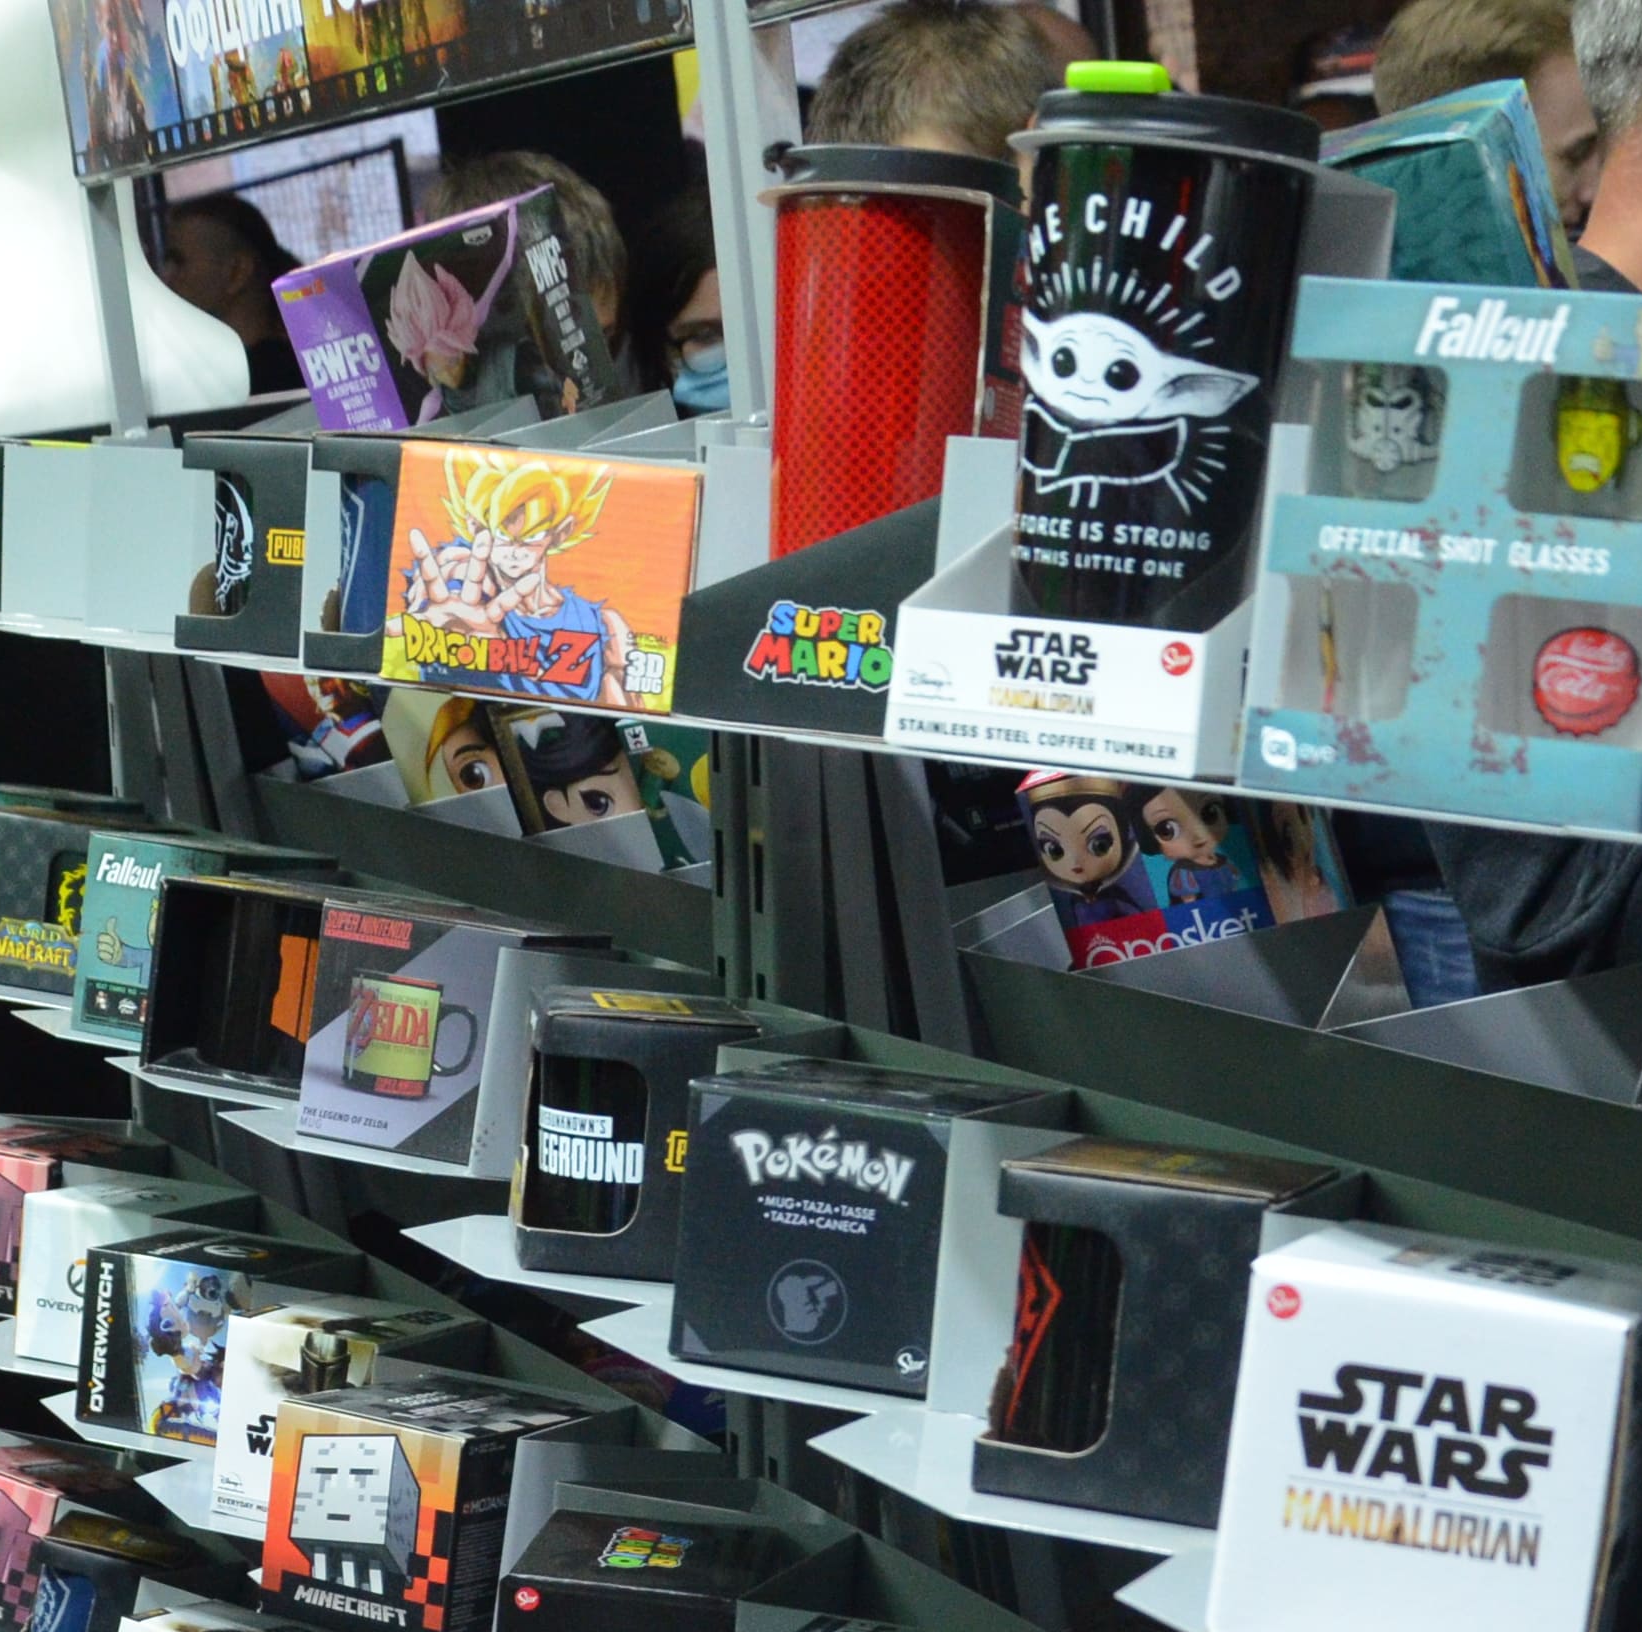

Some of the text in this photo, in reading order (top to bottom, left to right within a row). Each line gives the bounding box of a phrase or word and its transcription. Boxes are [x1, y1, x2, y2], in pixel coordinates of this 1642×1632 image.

[1084, 193, 1242, 301] CHILD
[1415, 296, 1570, 363] Fallout
[301, 332, 381, 389] BWFC
[274, 532, 305, 560] PUB
[1079, 521, 1104, 542] IS
[1113, 524, 1211, 551] STRONG
[1319, 524, 1610, 576] OFFICIAL SHOT GLASSES
[1033, 547, 1069, 567] THIS
[1074, 553, 1136, 574] LITTLE
[1142, 560, 1185, 578] ONE
[769, 602, 883, 648] SUPER
[995, 629, 1098, 660] STAR
[540, 628, 601, 687] Z
[625, 649, 665, 678] 3D
[745, 631, 893, 692] MARIO
[995, 651, 1098, 686] WARS
[625, 677, 663, 694] MUG
[989, 687, 1095, 716] MANDALORIAN
[898, 717, 1178, 760] STAINLESS STEEL COFFEE TUMBLER
[96, 852, 162, 891] Fallout
[6, 923, 62, 942] WORLD
[348, 986, 431, 1048] ZELDA
[299, 1116, 322, 1129] MUG
[303, 1105, 389, 1130] THE LEGEND OF ZELDA
[90, 1261, 115, 1412] OVERWATCH
[1298, 1362, 1554, 1447] STAR
[1298, 1415, 1551, 1500] WARS
[217, 1496, 255, 1510] EVERYDAY
[1282, 1485, 1542, 1568] MANDALORIAN
[293, 1584, 408, 1628] MINECRAFT
